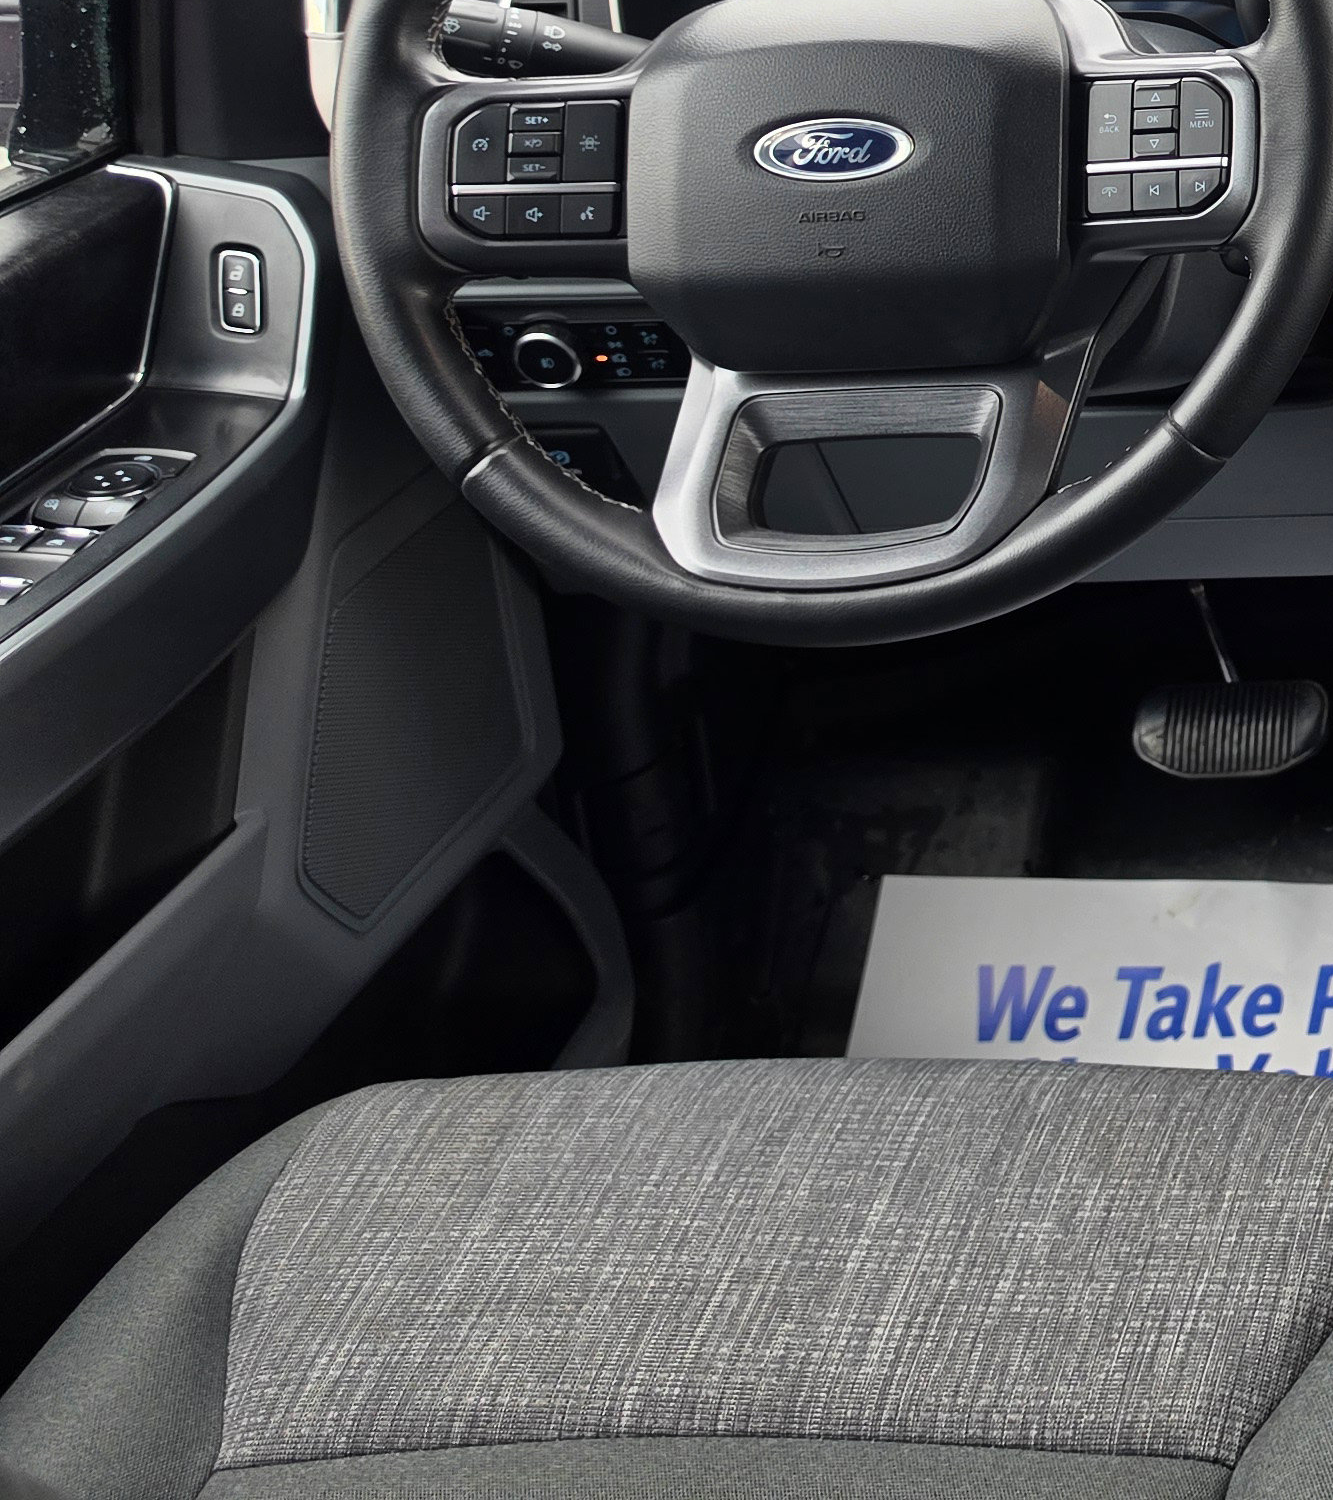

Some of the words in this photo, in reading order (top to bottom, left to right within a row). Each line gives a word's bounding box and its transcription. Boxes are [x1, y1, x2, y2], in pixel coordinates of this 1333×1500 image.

[1146, 115, 1159, 124] OK
[1189, 120, 1215, 129] MENU
[1099, 125, 1120, 134] BACK
[792, 131, 873, 166] Ford
[799, 210, 867, 224] AIRBAG
[975, 963, 1090, 1044] We
[1114, 961, 1284, 1043] Take
